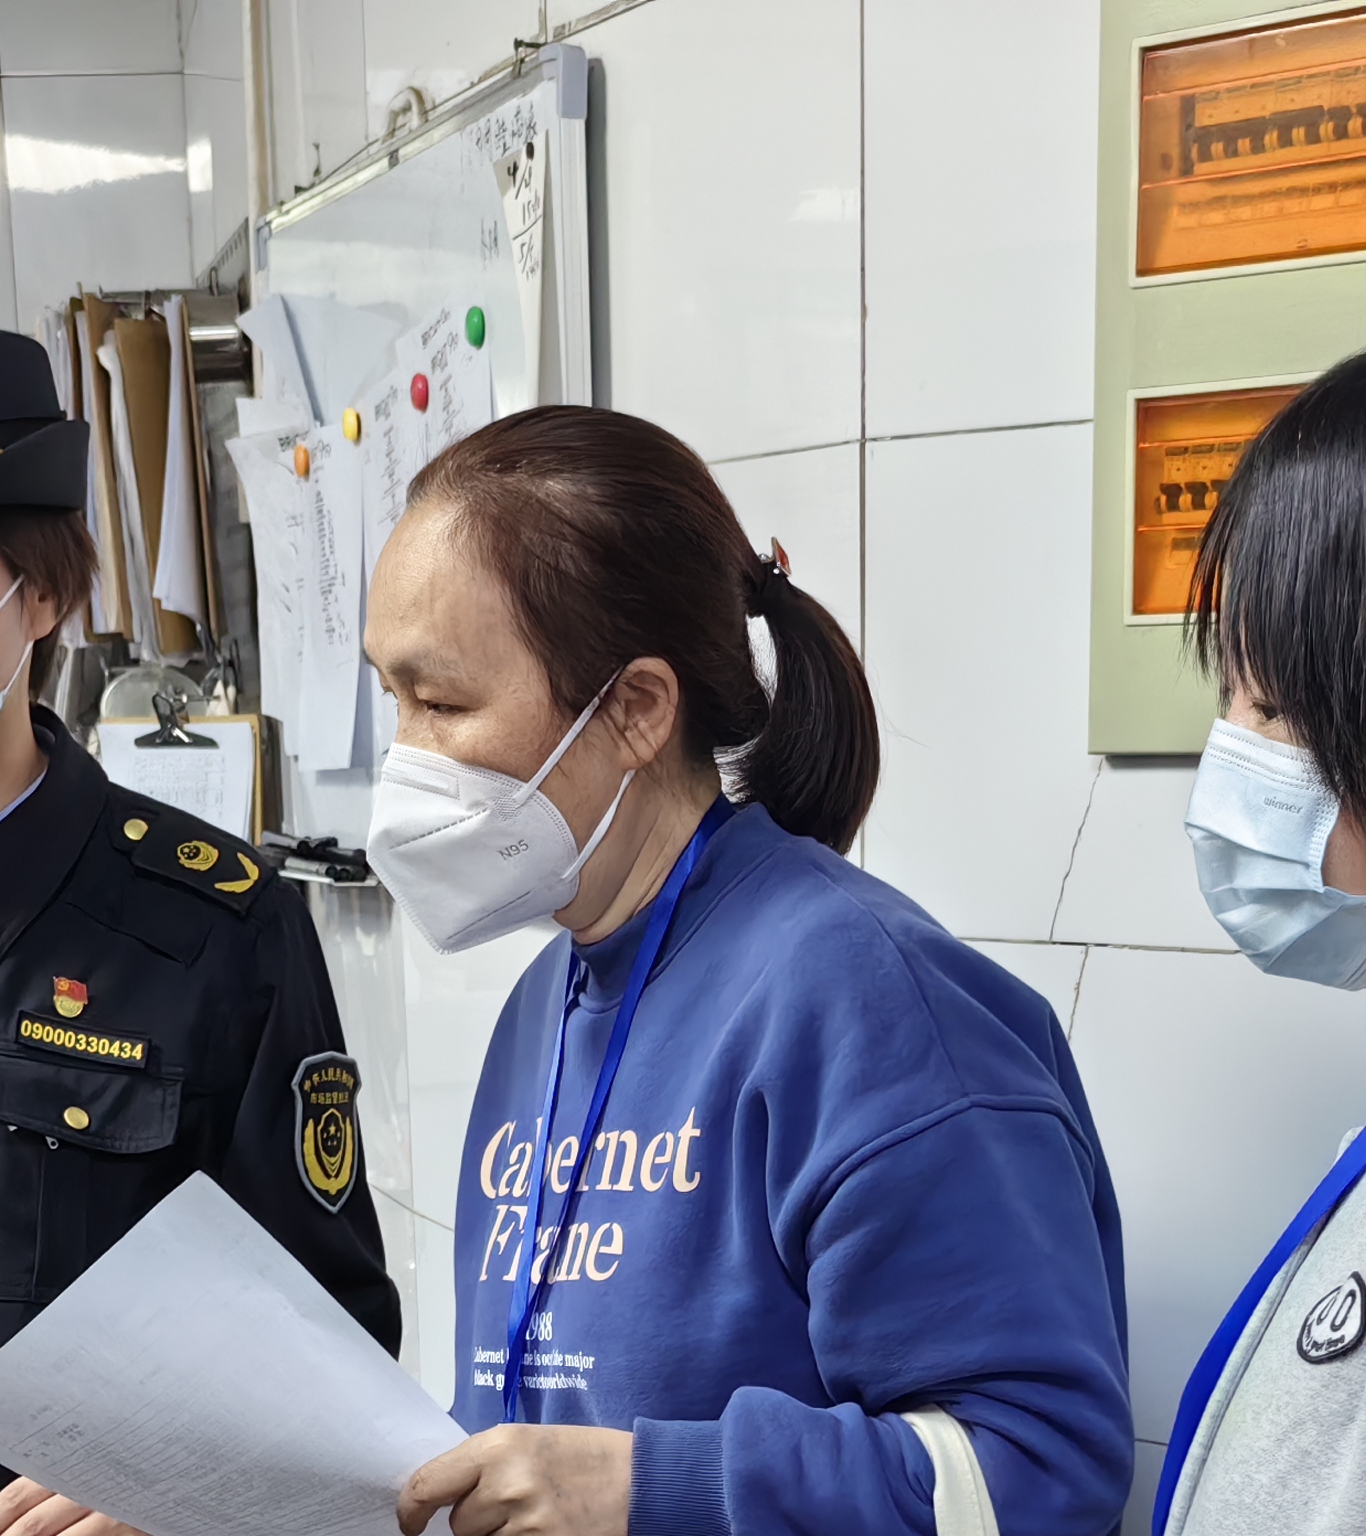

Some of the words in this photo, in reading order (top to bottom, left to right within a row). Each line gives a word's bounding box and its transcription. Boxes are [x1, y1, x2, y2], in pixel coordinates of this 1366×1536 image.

[1263, 796, 1303, 814] winner
[496, 839, 529, 861] N95
[20, 1019, 144, 1061] 09000330434
[565, 1351, 596, 1372] major
